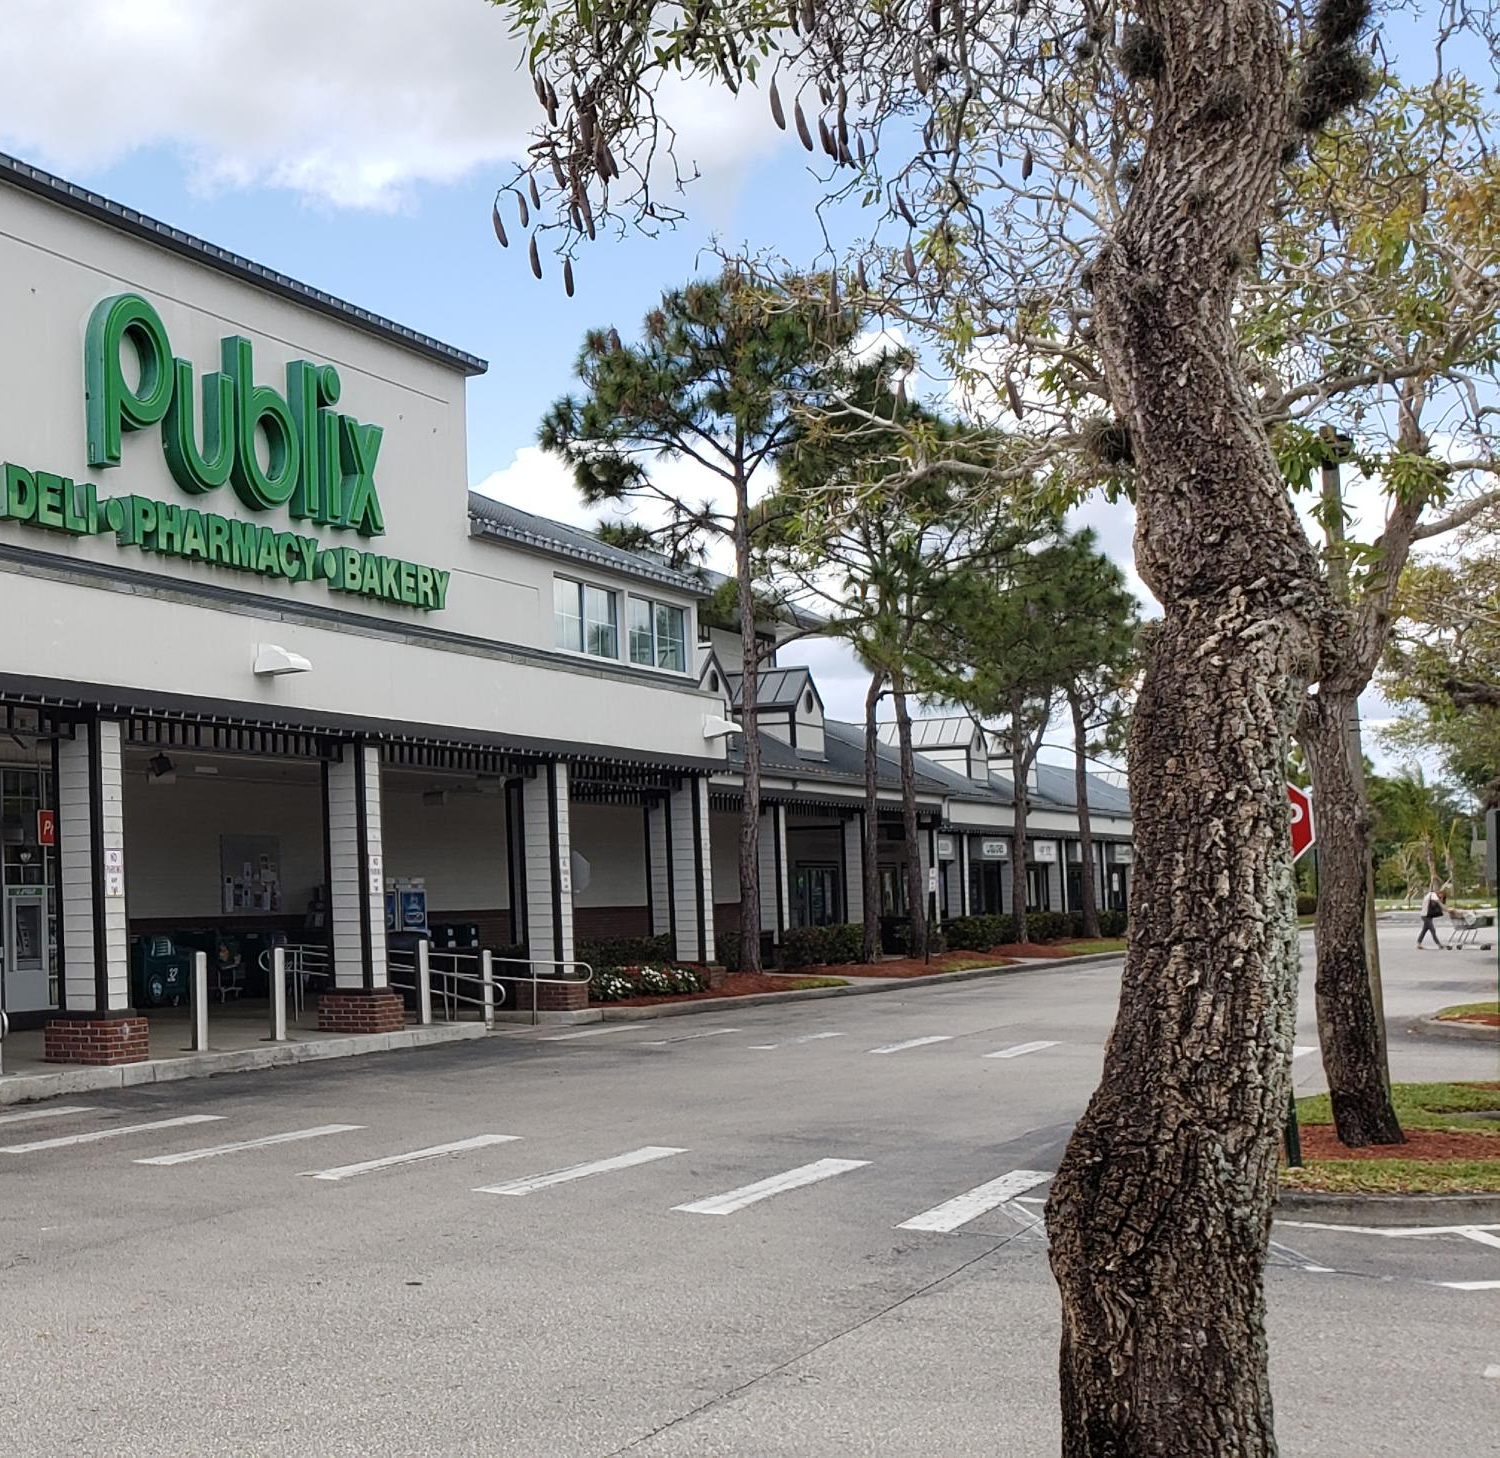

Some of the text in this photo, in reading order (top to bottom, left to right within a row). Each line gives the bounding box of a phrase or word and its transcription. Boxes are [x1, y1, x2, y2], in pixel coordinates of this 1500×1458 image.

[85, 292, 386, 536] Publix
[126, 494, 319, 582] PHARMACY
[338, 547, 450, 611] BAKERY
